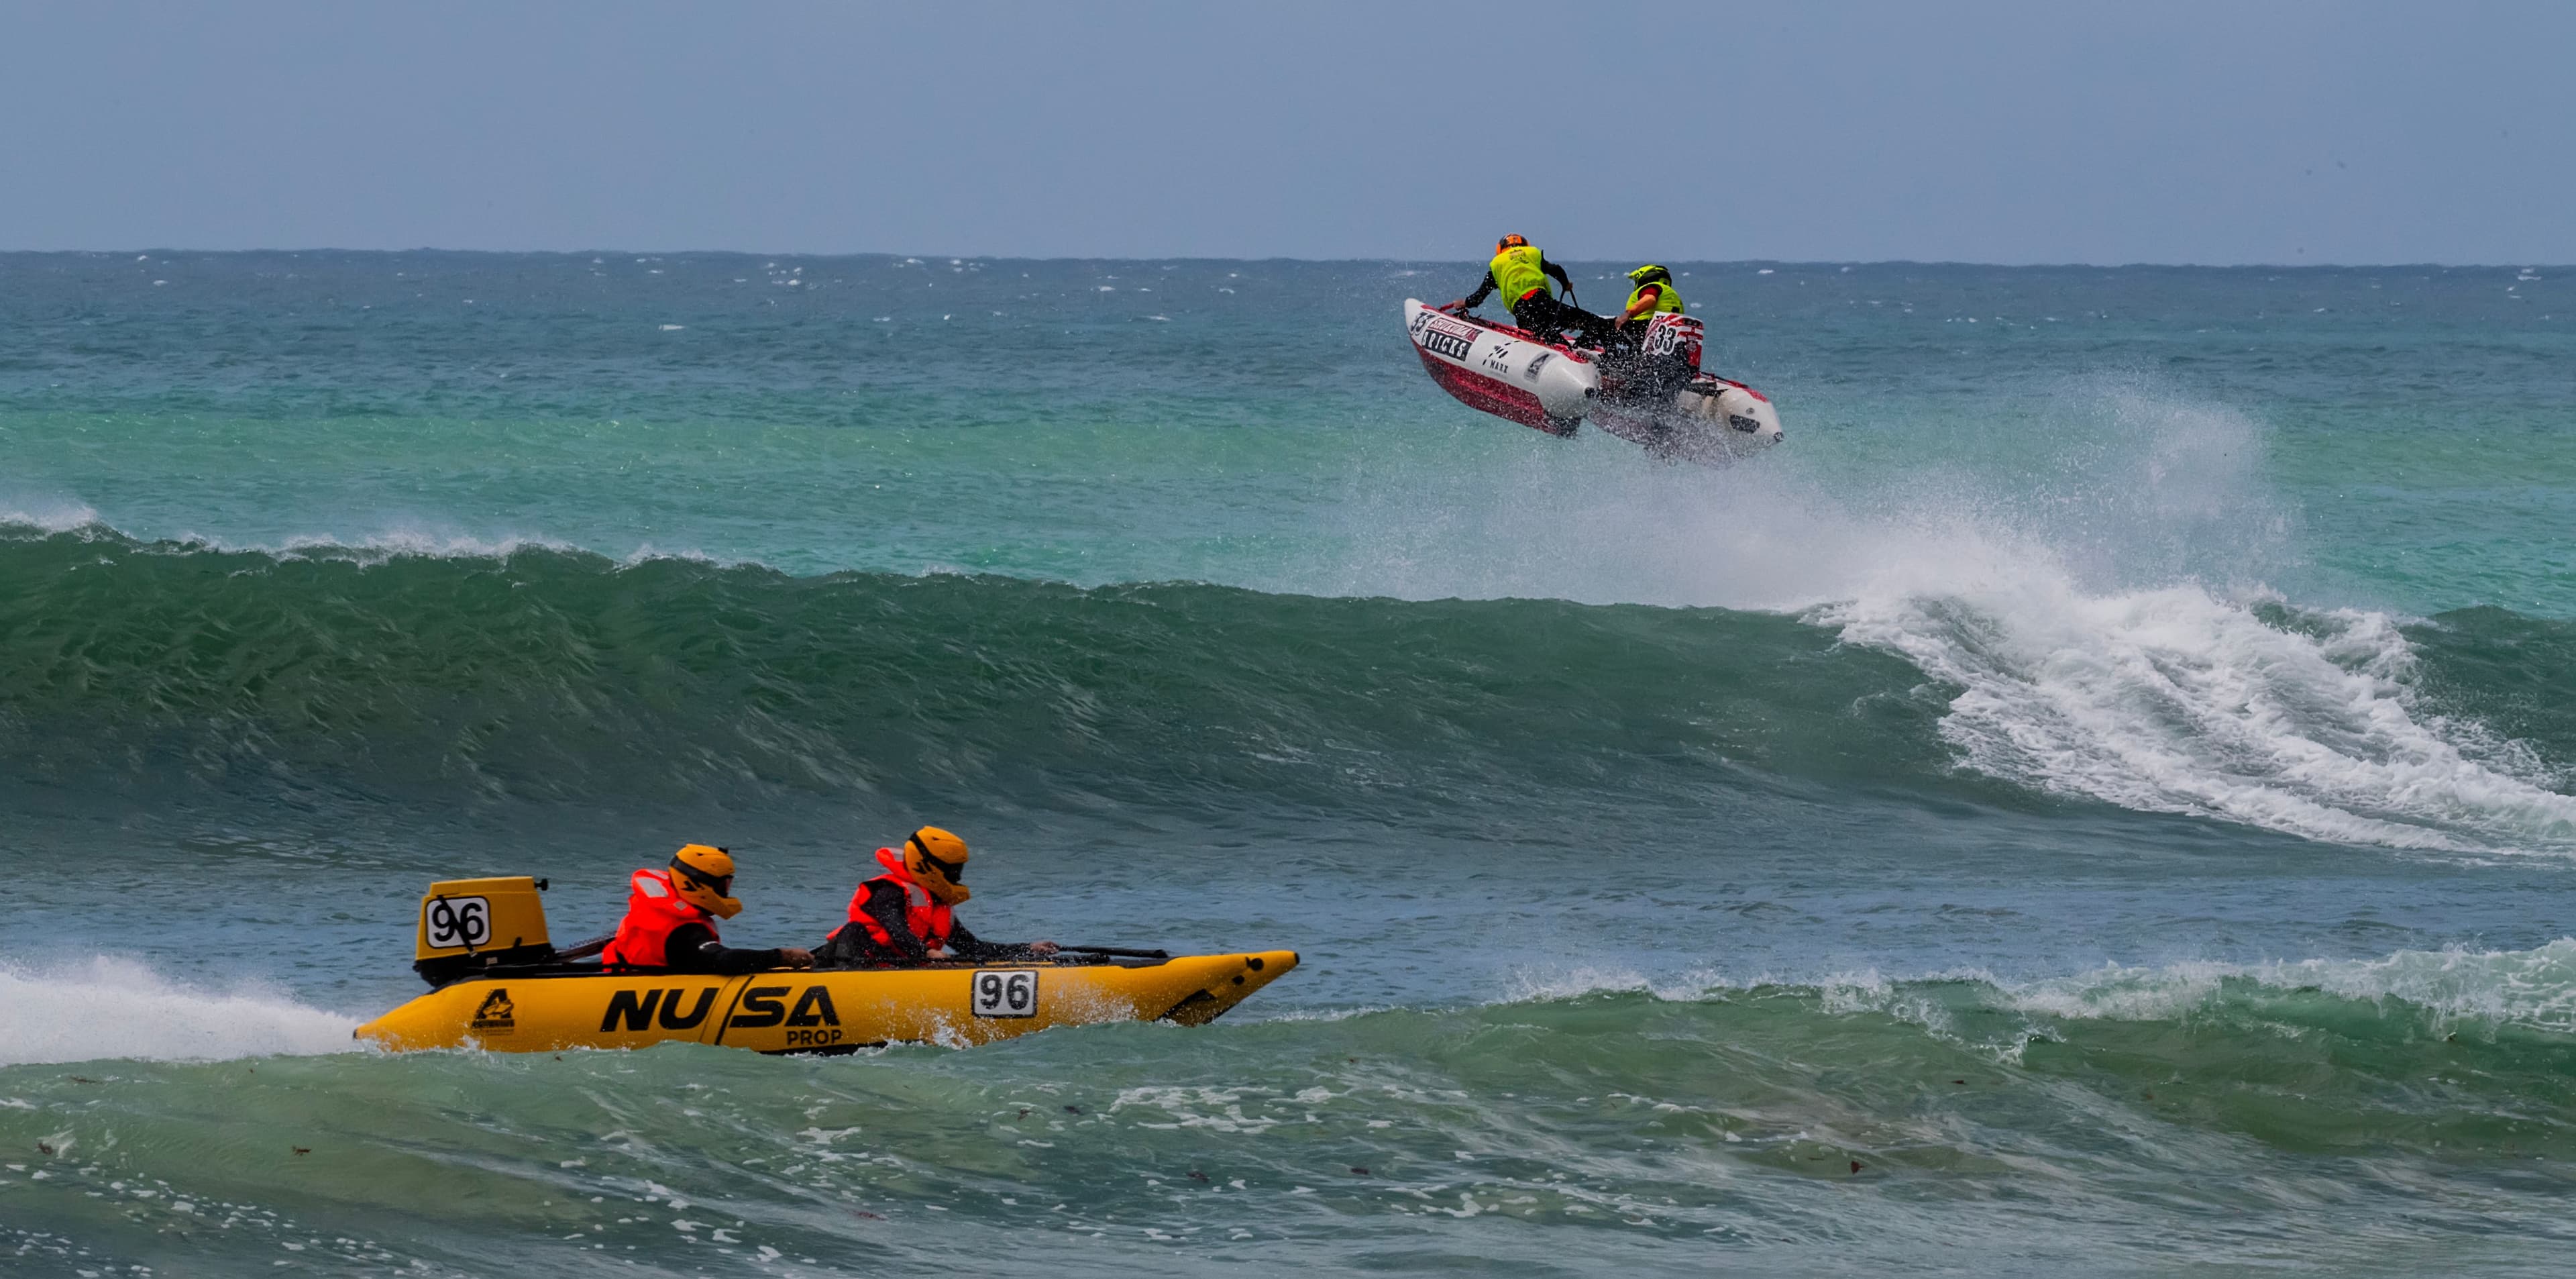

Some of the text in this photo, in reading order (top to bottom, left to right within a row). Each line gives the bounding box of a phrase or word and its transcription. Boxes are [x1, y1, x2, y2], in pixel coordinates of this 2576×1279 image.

[1422, 331, 1467, 357] BRICKS
[1654, 324, 1676, 353] 33
[432, 903, 484, 941] 96
[981, 974, 1030, 1010] 96
[787, 1029, 843, 1045] PROP
